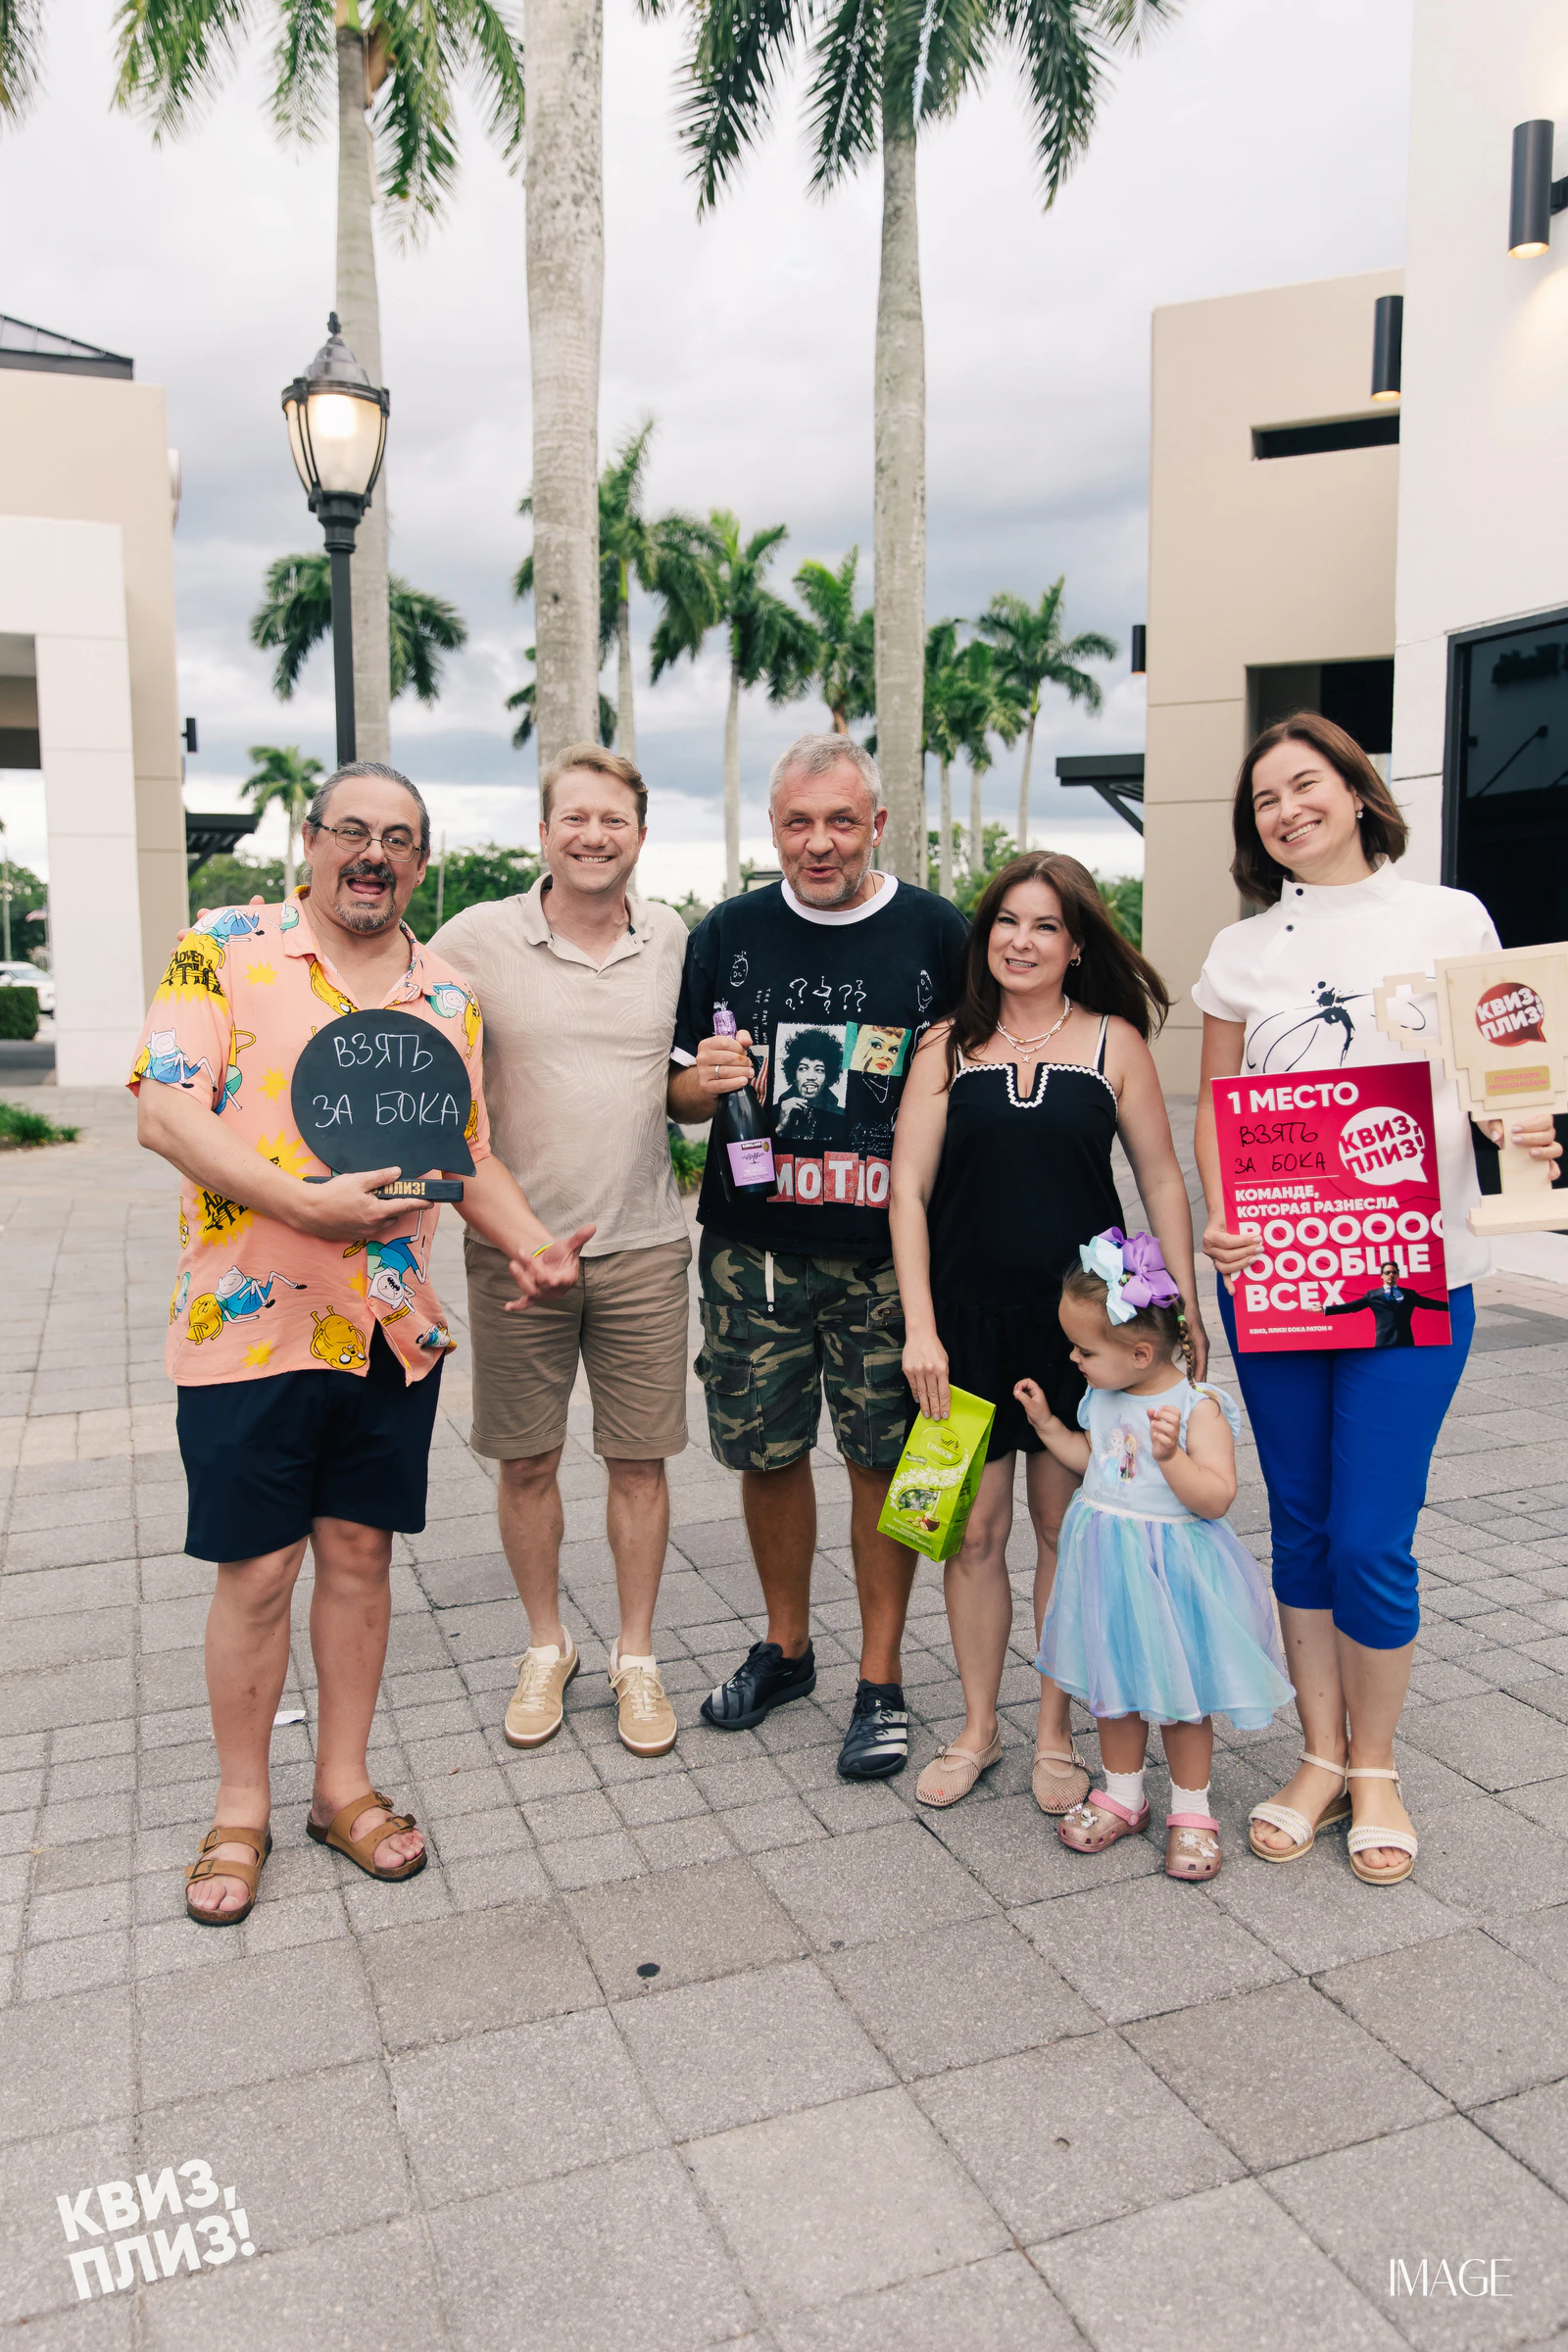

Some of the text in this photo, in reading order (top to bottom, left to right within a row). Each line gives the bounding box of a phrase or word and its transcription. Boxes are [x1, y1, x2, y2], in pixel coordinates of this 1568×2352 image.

[1476, 987, 1542, 1022] КВИЗ,
[1480, 1003, 1544, 1041] ПЛИЗ!
[333, 1033, 434, 1072] ВЗЯТЬ
[313, 1090, 460, 1128] ЗА БОКА
[1227, 1081, 1359, 1114] 1 МЕСТО
[1239, 1122, 1318, 1148] ВЗЯТЬ
[1340, 1115, 1420, 1154] КВИЗ,
[1235, 1152, 1326, 1174] ЗА БОКА
[1345, 1135, 1425, 1176] ПЛИЗ!
[1235, 1185, 1319, 1201] КОМАНДЕ,
[1237, 1197, 1399, 1218] КОТОРАЯ РАЗНЕСЛА
[1245, 1280, 1347, 1312] ВСЕХ
